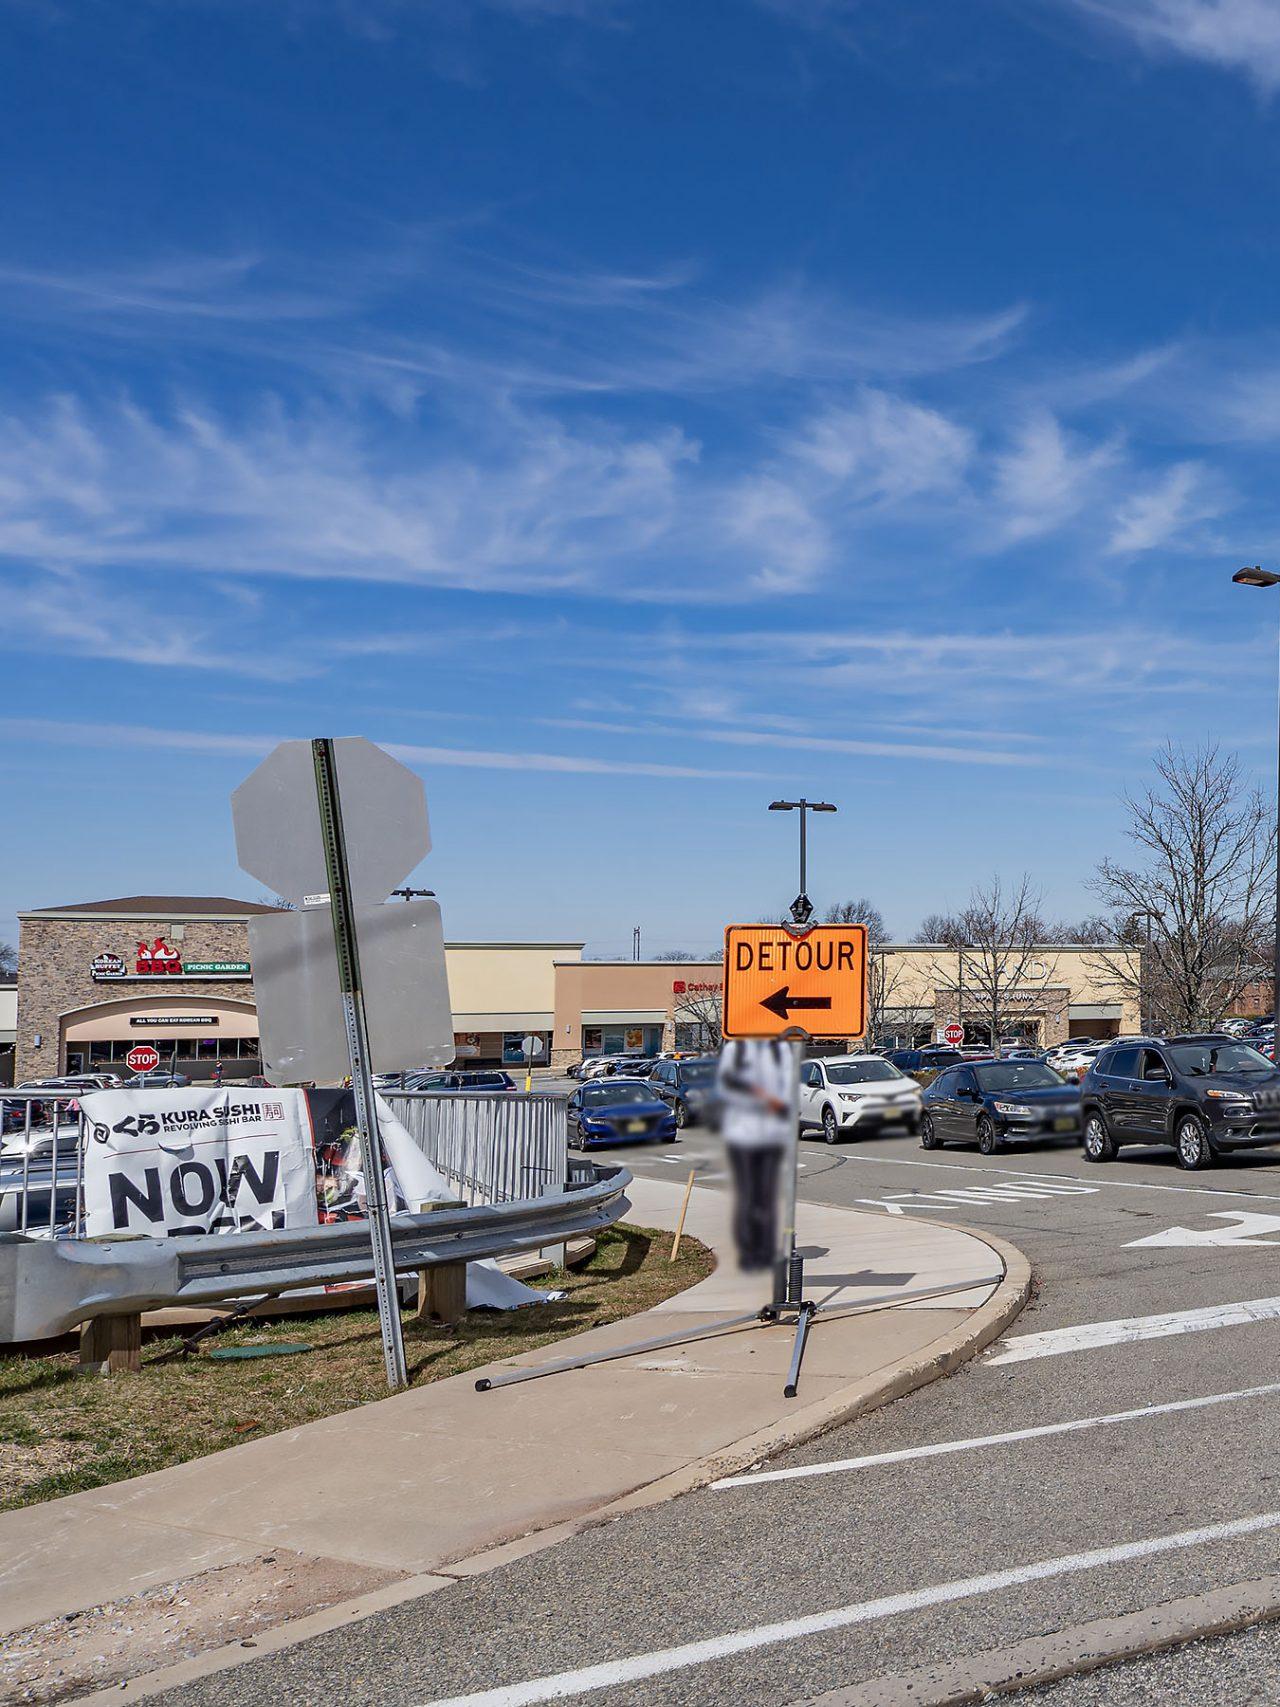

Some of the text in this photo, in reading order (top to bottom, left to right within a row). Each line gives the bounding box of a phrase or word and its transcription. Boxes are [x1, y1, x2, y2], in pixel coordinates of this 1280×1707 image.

[736, 941, 855, 971] DETOUR
[136, 960, 182, 974] BBQ
[129, 1055, 156, 1064] STOP
[161, 1109, 211, 1124] KURA
[164, 1120, 217, 1133] REVOLVING
[242, 1115, 262, 1123] BAR
[108, 1151, 280, 1229] NOW
